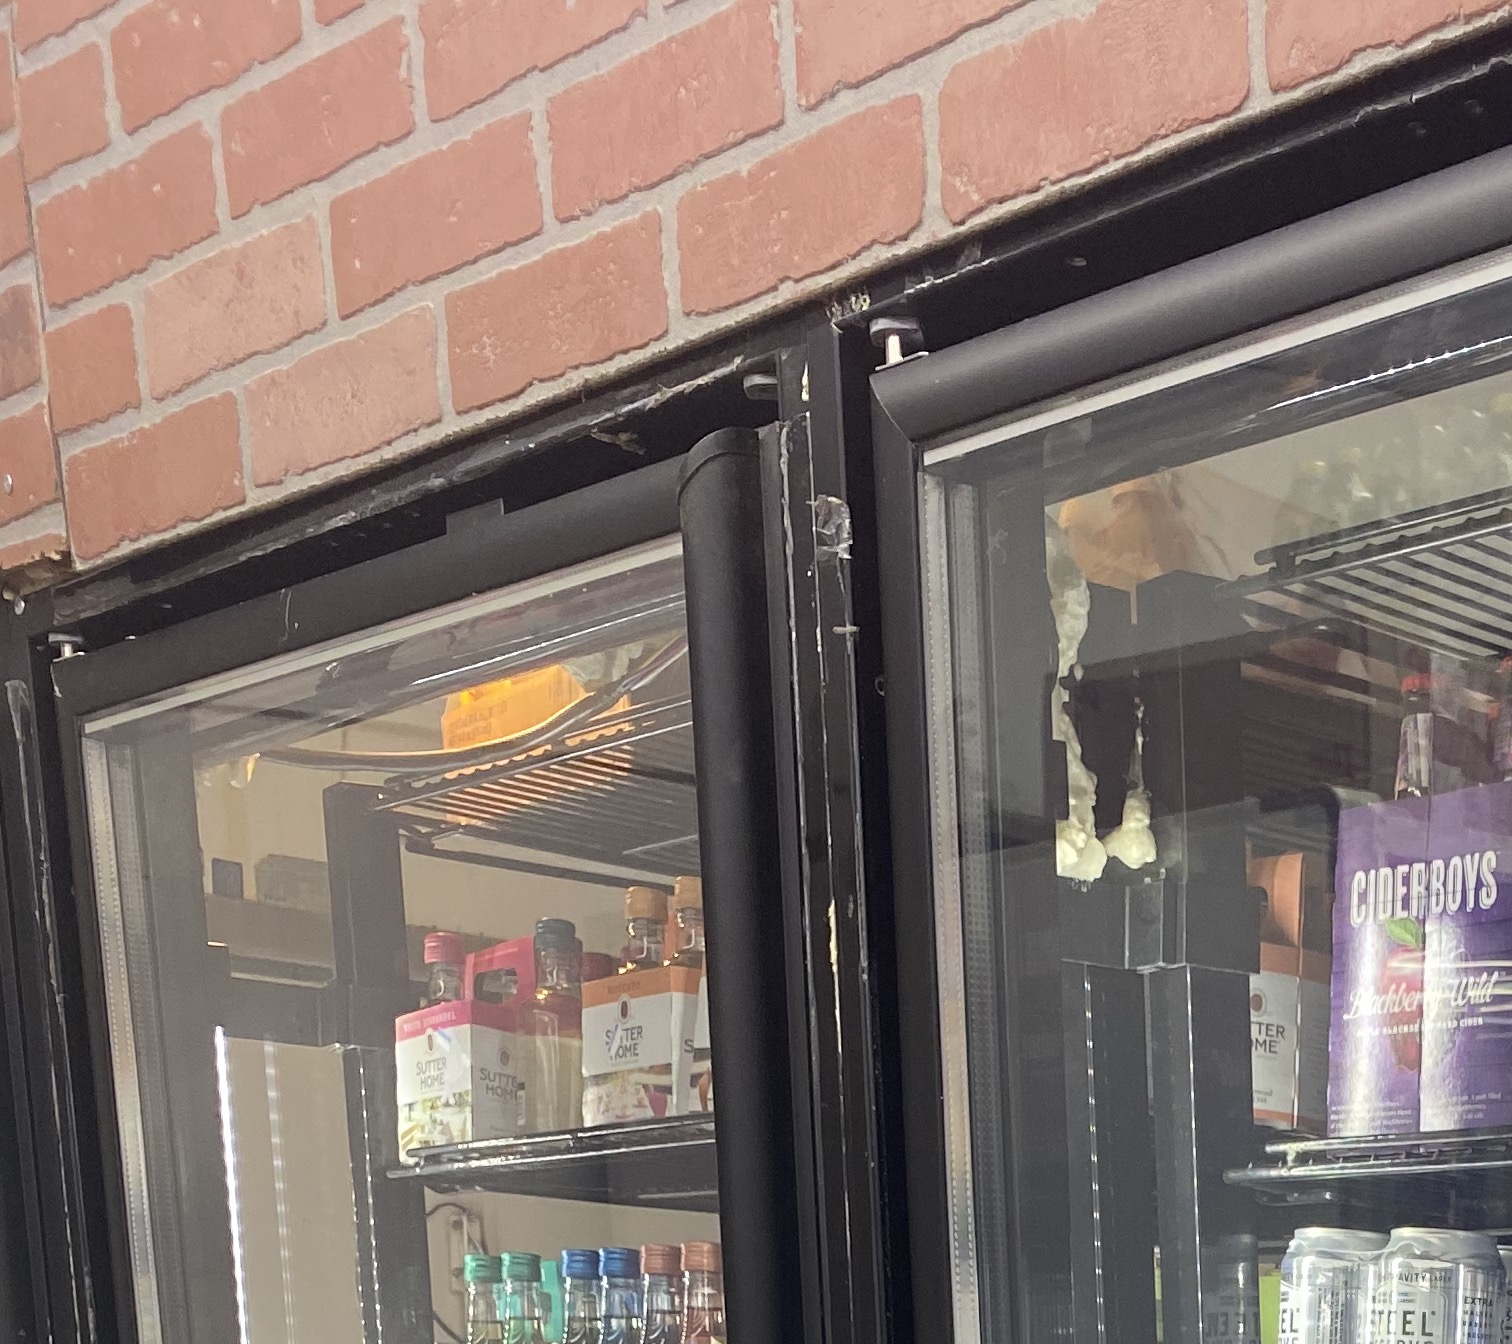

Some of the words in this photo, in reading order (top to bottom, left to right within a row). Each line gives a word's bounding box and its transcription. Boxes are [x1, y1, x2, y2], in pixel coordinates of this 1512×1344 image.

[1351, 850, 1498, 928] CIDERBOYS
[416, 1058, 447, 1077] SUTTER
[420, 1073, 445, 1090] HOME
